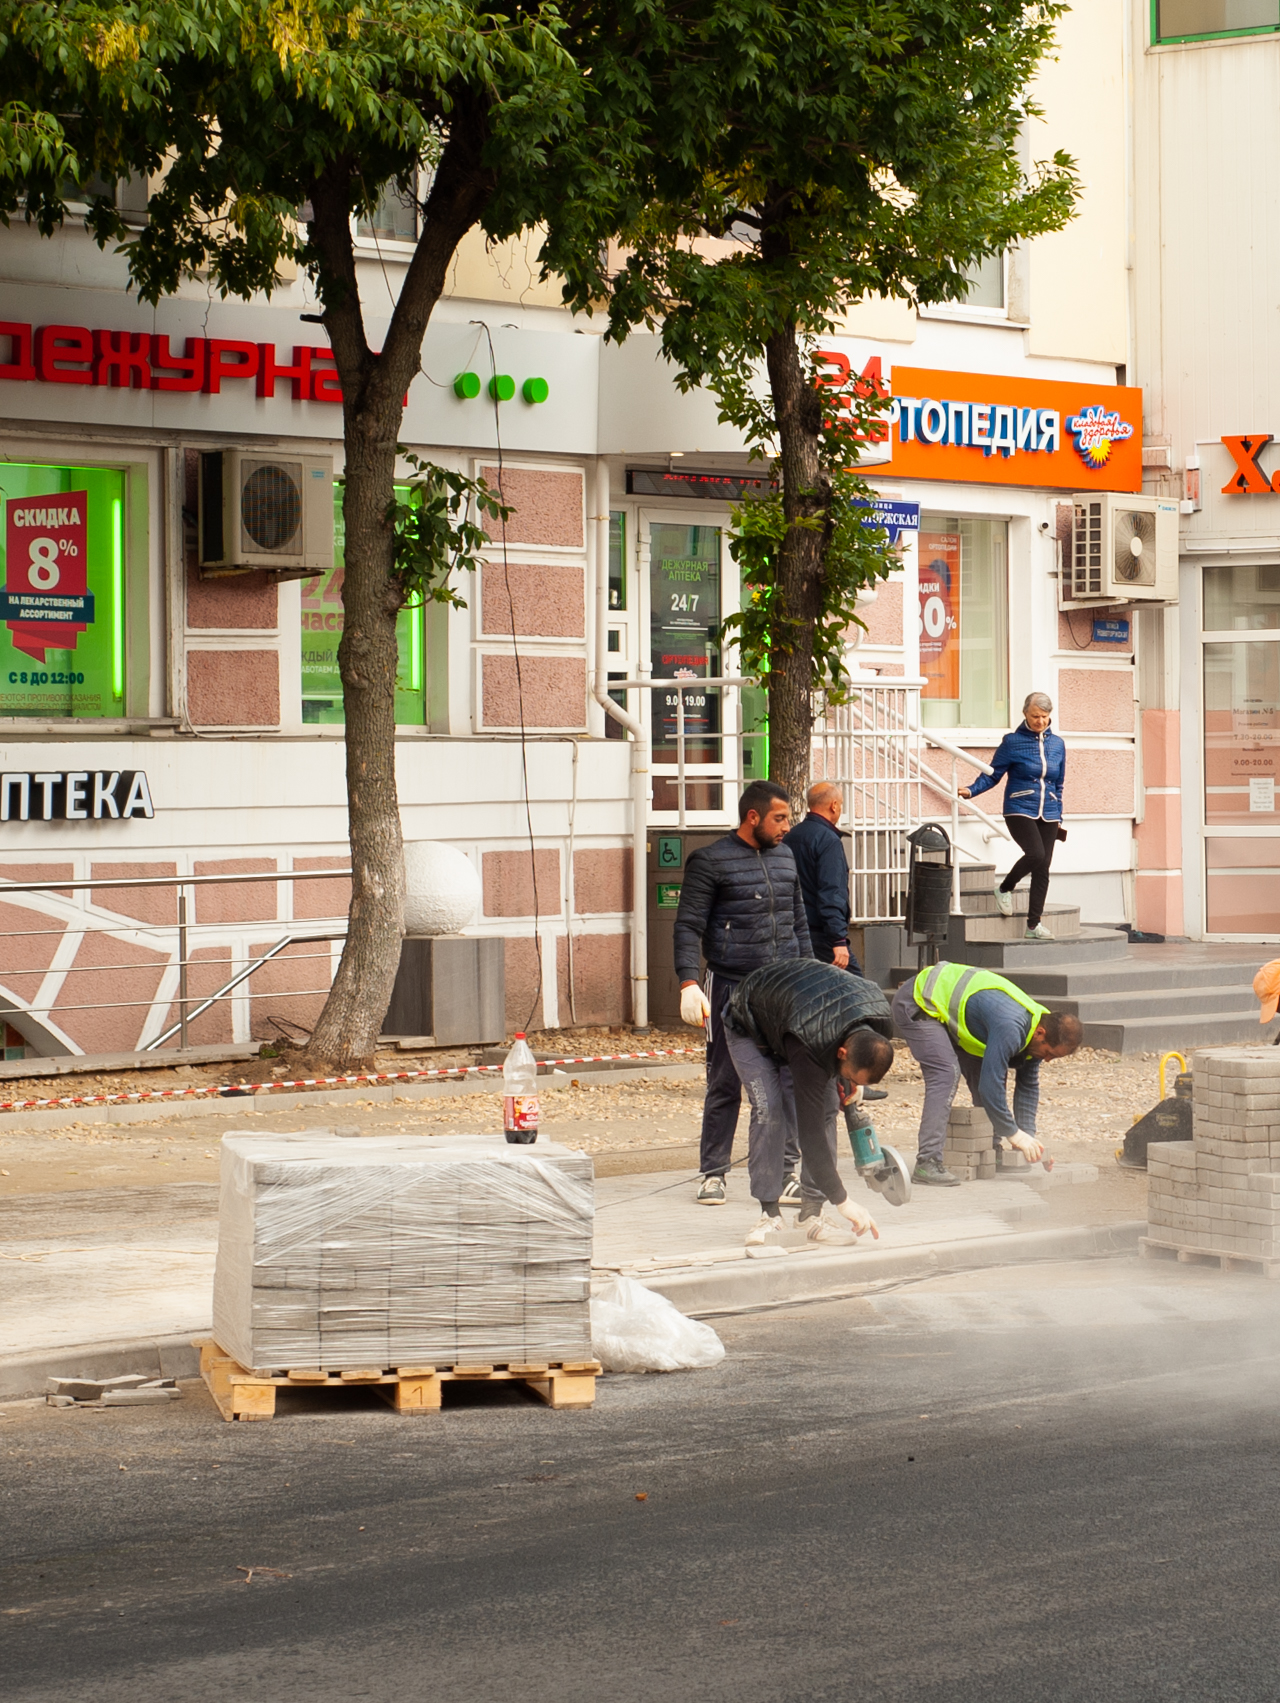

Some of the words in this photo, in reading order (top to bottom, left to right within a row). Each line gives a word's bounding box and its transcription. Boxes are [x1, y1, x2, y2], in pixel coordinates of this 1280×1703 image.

[13, 507, 81, 529] СКИДКА
[661, 559, 709, 572] ДЕЖУРНАЯ
[668, 571, 702, 582] АПТЕКА
[919, 583, 940, 594] ИДКИ
[8, 595, 19, 605] НА
[20, 596, 85, 608] ЛЕКАРСТВЕННЫЙ
[671, 593, 700, 612] 24/7
[19, 608, 74, 620] АССОРТИМЕНТ
[661, 654, 709, 667] ОРТОПЕДИЯ
[8, 671, 18, 684] С
[20, 671, 28, 684] 8
[30, 672, 49, 686] ДО
[50, 672, 85, 685] 12:00
[685, 695, 706, 706] 19.00
